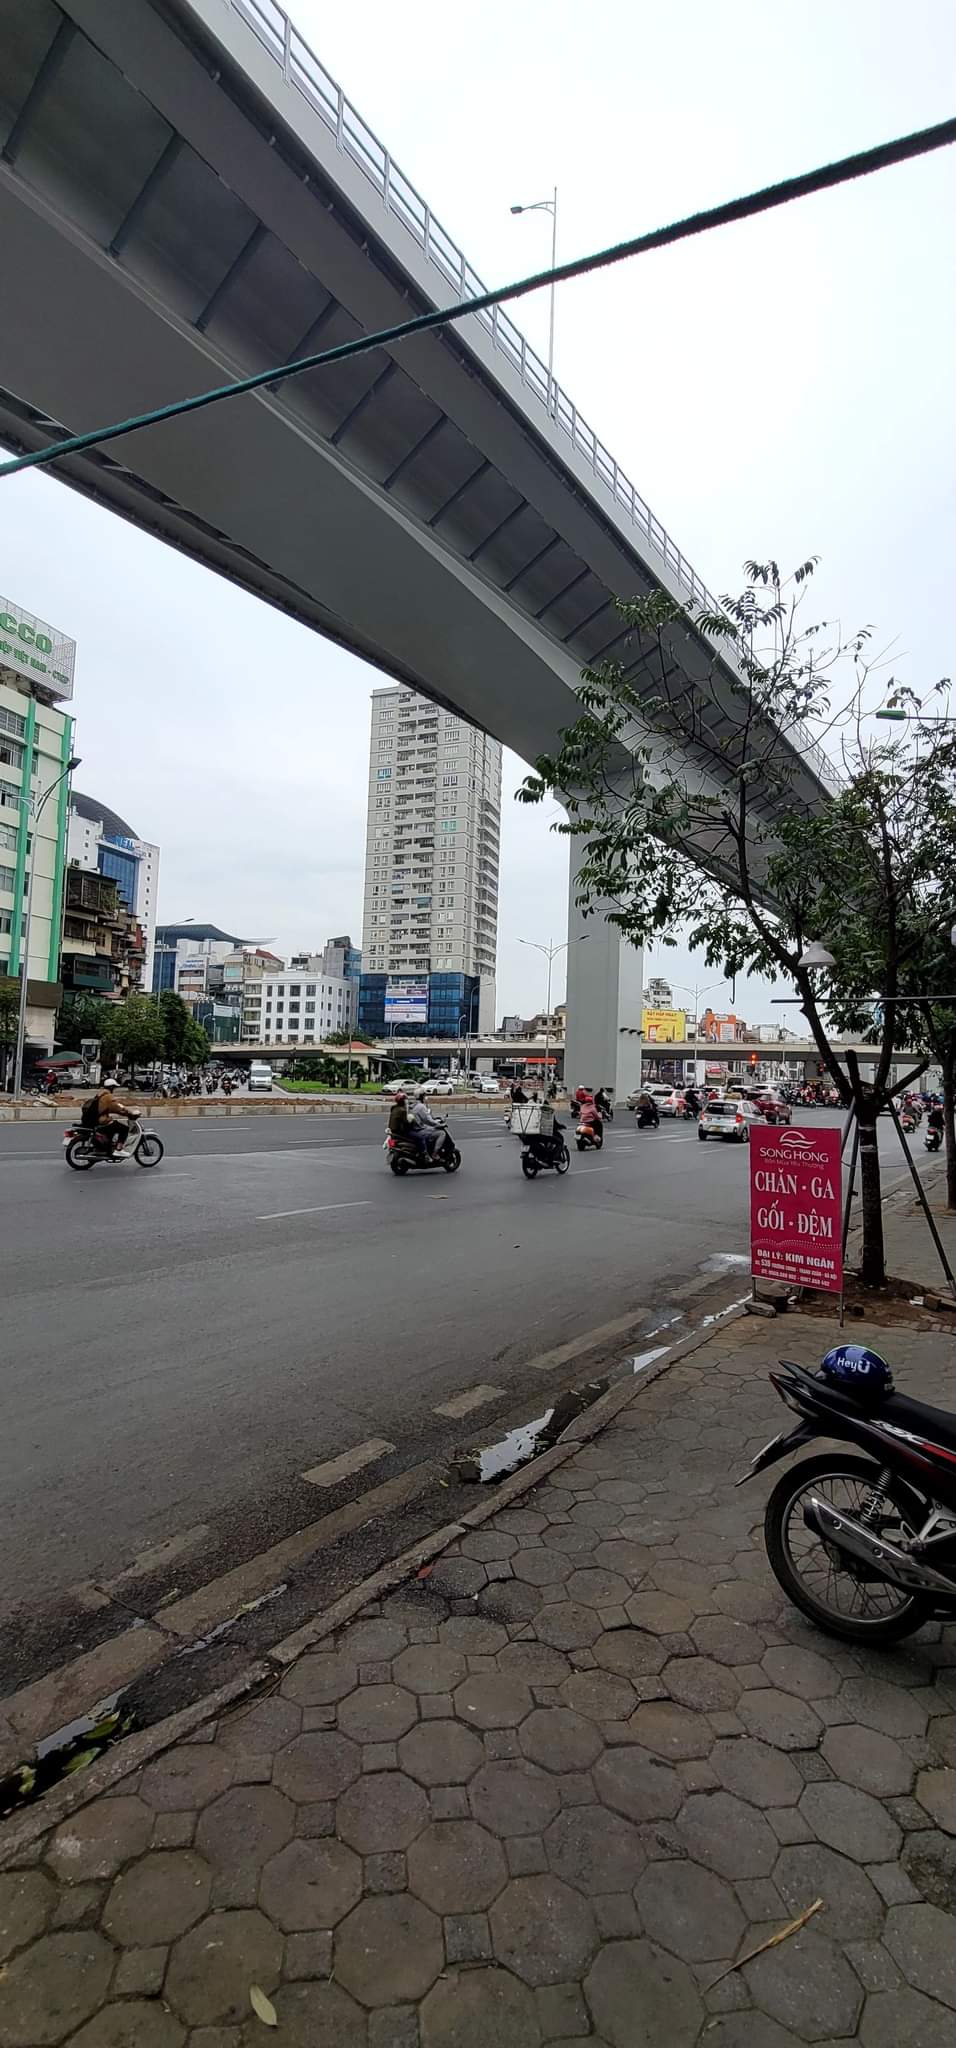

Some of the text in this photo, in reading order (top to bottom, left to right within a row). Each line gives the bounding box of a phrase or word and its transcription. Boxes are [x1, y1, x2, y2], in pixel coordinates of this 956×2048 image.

[30, 656, 47, 673] NAM
[754, 1167, 798, 1195] CHĂN
[811, 1176, 835, 1200] GA
[757, 1199, 785, 1231] GỐI
[797, 1208, 833, 1242] ĐỆM
[785, 1252, 804, 1265] KIM
[806, 1255, 835, 1269] NGÂN
[837, 1356, 871, 1374] HeyU
